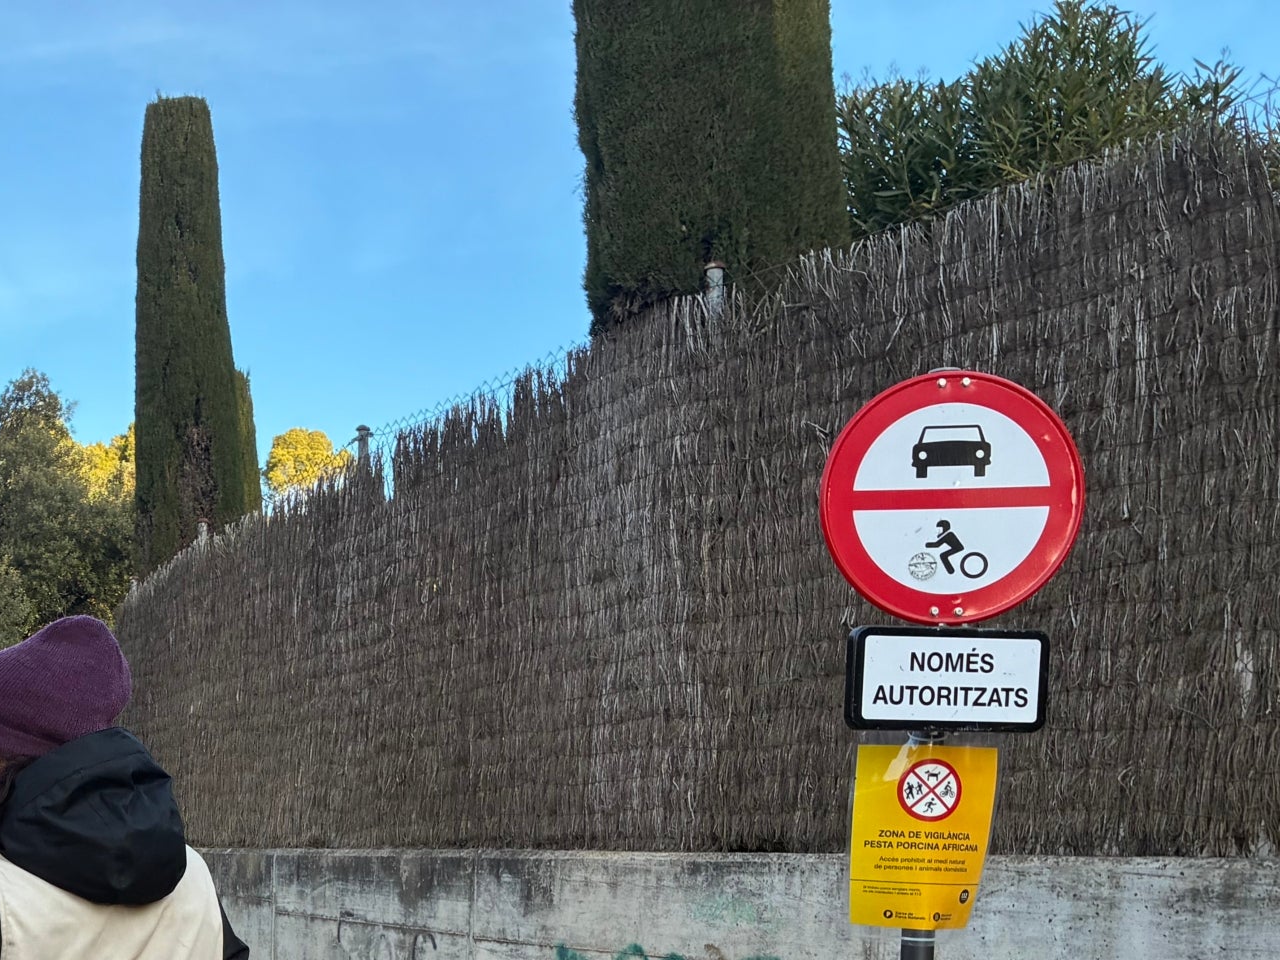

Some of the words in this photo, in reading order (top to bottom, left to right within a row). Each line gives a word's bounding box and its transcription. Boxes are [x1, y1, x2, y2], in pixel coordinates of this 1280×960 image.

[910, 648, 995, 673] NOMÉS
[872, 685, 1029, 708] AUTORITZATS
[878, 829, 905, 839] ZONA
[908, 830, 922, 839] DE
[924, 830, 971, 841] VIGILÀNCIA
[863, 840, 894, 849] PESTA
[896, 841, 940, 851] PORCINA
[941, 843, 978, 852] AFRICANA
